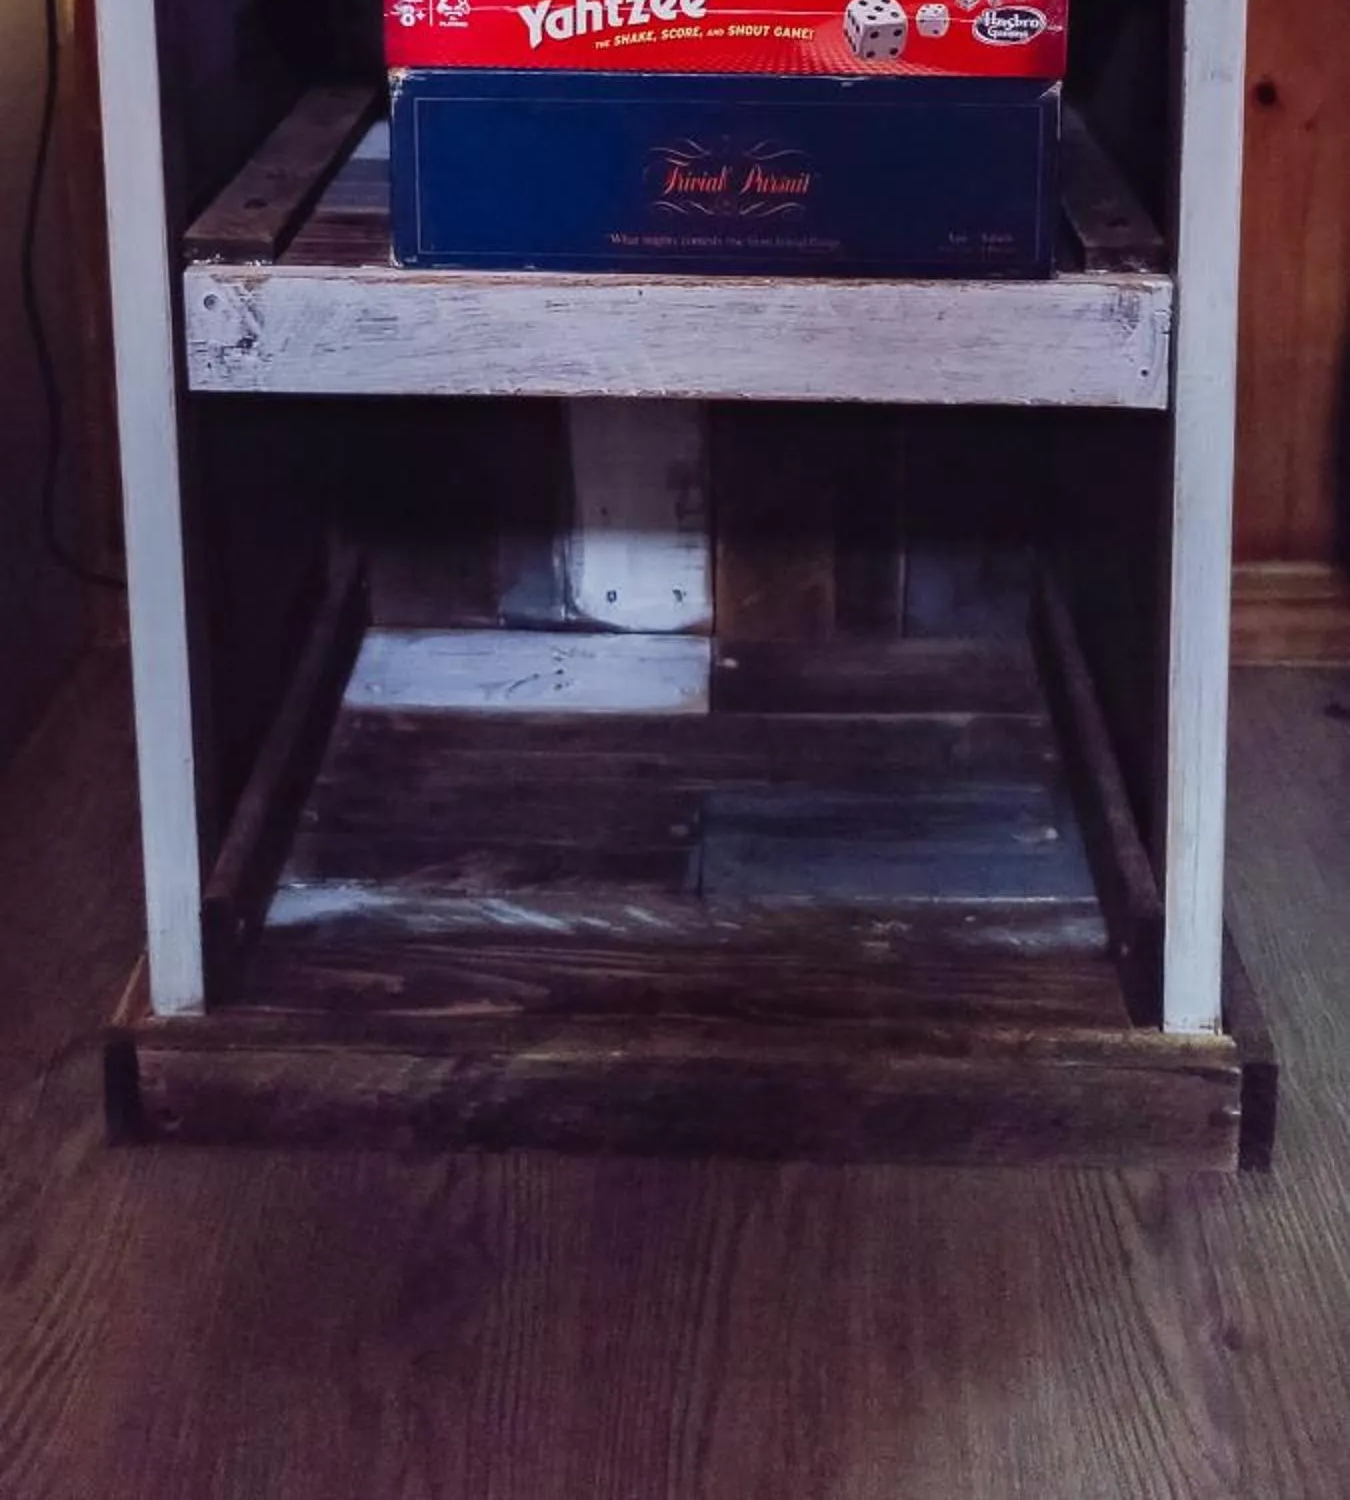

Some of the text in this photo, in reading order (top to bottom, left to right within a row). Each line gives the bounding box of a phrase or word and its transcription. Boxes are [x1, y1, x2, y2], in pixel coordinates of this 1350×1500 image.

[984, 11, 1040, 31] Hasbro
[613, 30, 657, 47] SHAKE,
[661, 26, 703, 41] SCORE,
[728, 24, 771, 37] SHOUT
[773, 26, 816, 41] GAME!
[661, 157, 812, 195] Trivial Pursuit
